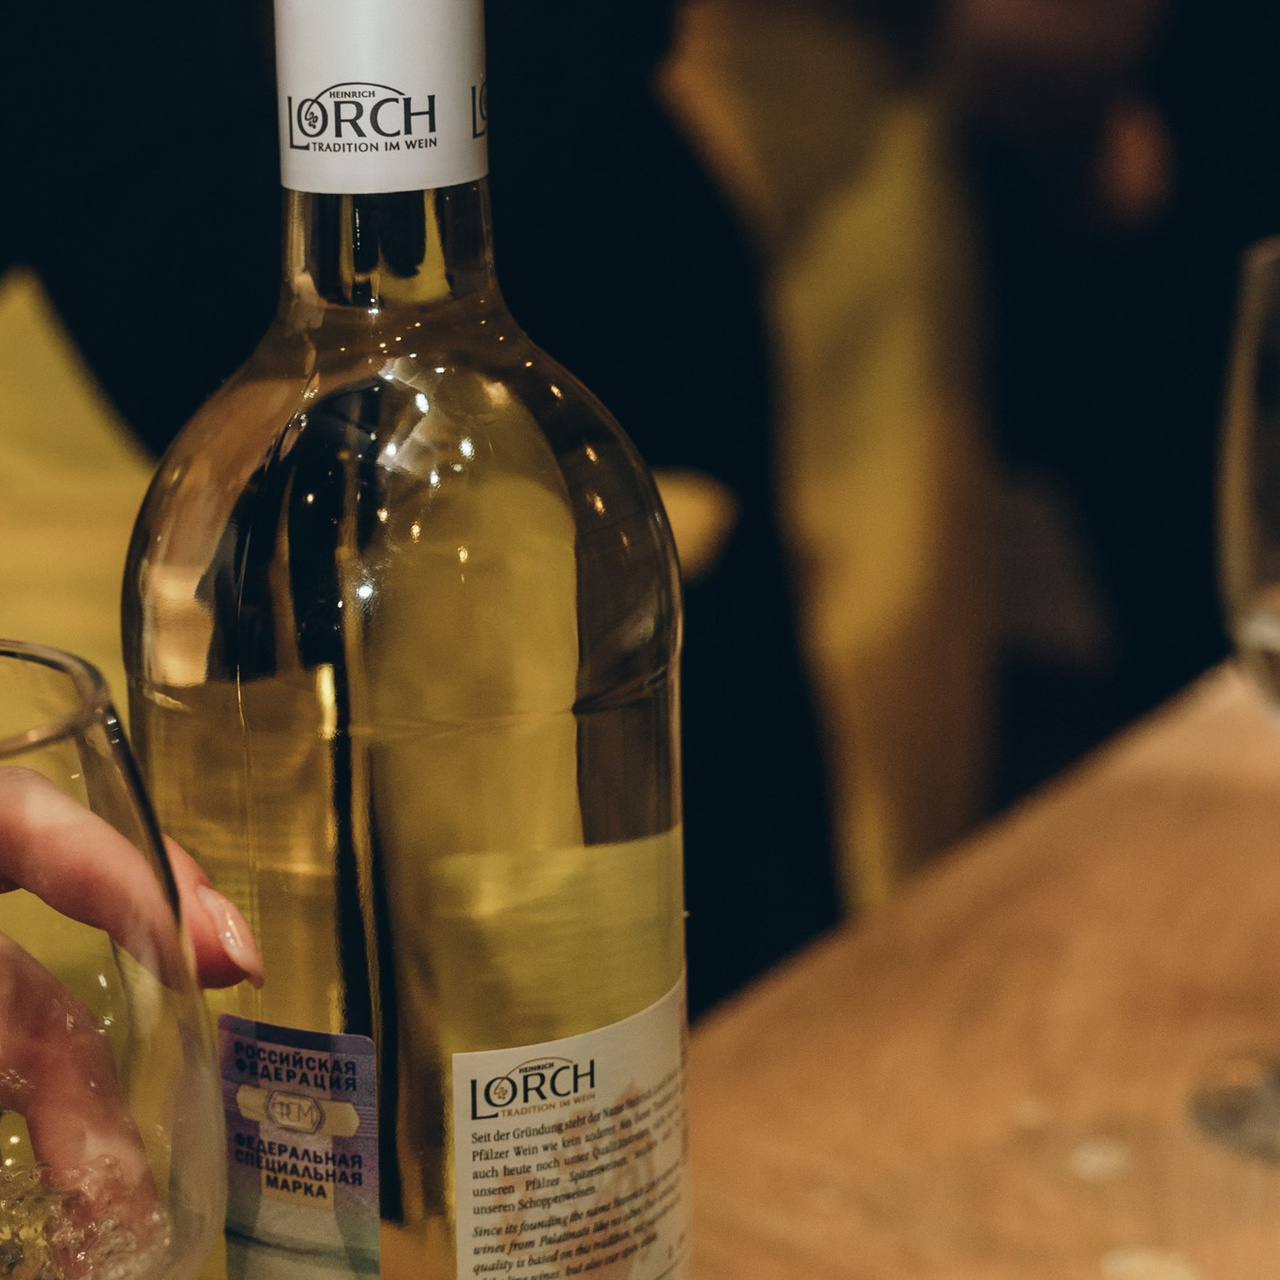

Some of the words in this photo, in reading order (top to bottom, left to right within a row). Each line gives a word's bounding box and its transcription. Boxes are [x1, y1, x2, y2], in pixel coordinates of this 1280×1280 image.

[328, 90, 376, 99] HEINRICH
[287, 95, 437, 150] LORCH
[311, 141, 379, 153] TRADITION
[384, 141, 401, 152] IM
[404, 137, 438, 150] WEIN
[233, 1041, 358, 1077] РОССИЙСКАЯ
[519, 1062, 555, 1073] HEINRICH
[234, 1057, 358, 1093] ФЕДЕРАЦИЯ
[470, 1058, 596, 1120] LORCH
[501, 1102, 556, 1118] TRADITION
[559, 1098, 571, 1109] IM
[573, 1093, 596, 1106] WEIN
[471, 1130, 491, 1144] Seit
[493, 1129, 511, 1141] der
[512, 1122, 563, 1140] Gründung
[234, 1131, 364, 1170] ФЕДЕРАЛЬНАЯ
[471, 1148, 510, 1162] Pfälzer
[513, 1144, 539, 1157] Wein
[541, 1142, 558, 1152] wie
[233, 1149, 364, 1187] СПЕЦИАЛЬНАЯ
[472, 1166, 499, 1180] auch
[502, 1165, 532, 1177] heute
[535, 1157, 560, 1172] noch
[265, 1174, 328, 1200] МАРКА
[472, 1184, 515, 1197] unseren
[525, 1177, 560, 1192] Pfälzer
[473, 1202, 516, 1215] unseren
[473, 1225, 502, 1238] Since
[505, 1223, 518, 1234] its
[519, 1215, 568, 1236] founding
[473, 1244, 506, 1256] wines
[507, 1240, 536, 1256] from
[473, 1259, 514, 1276] quality
